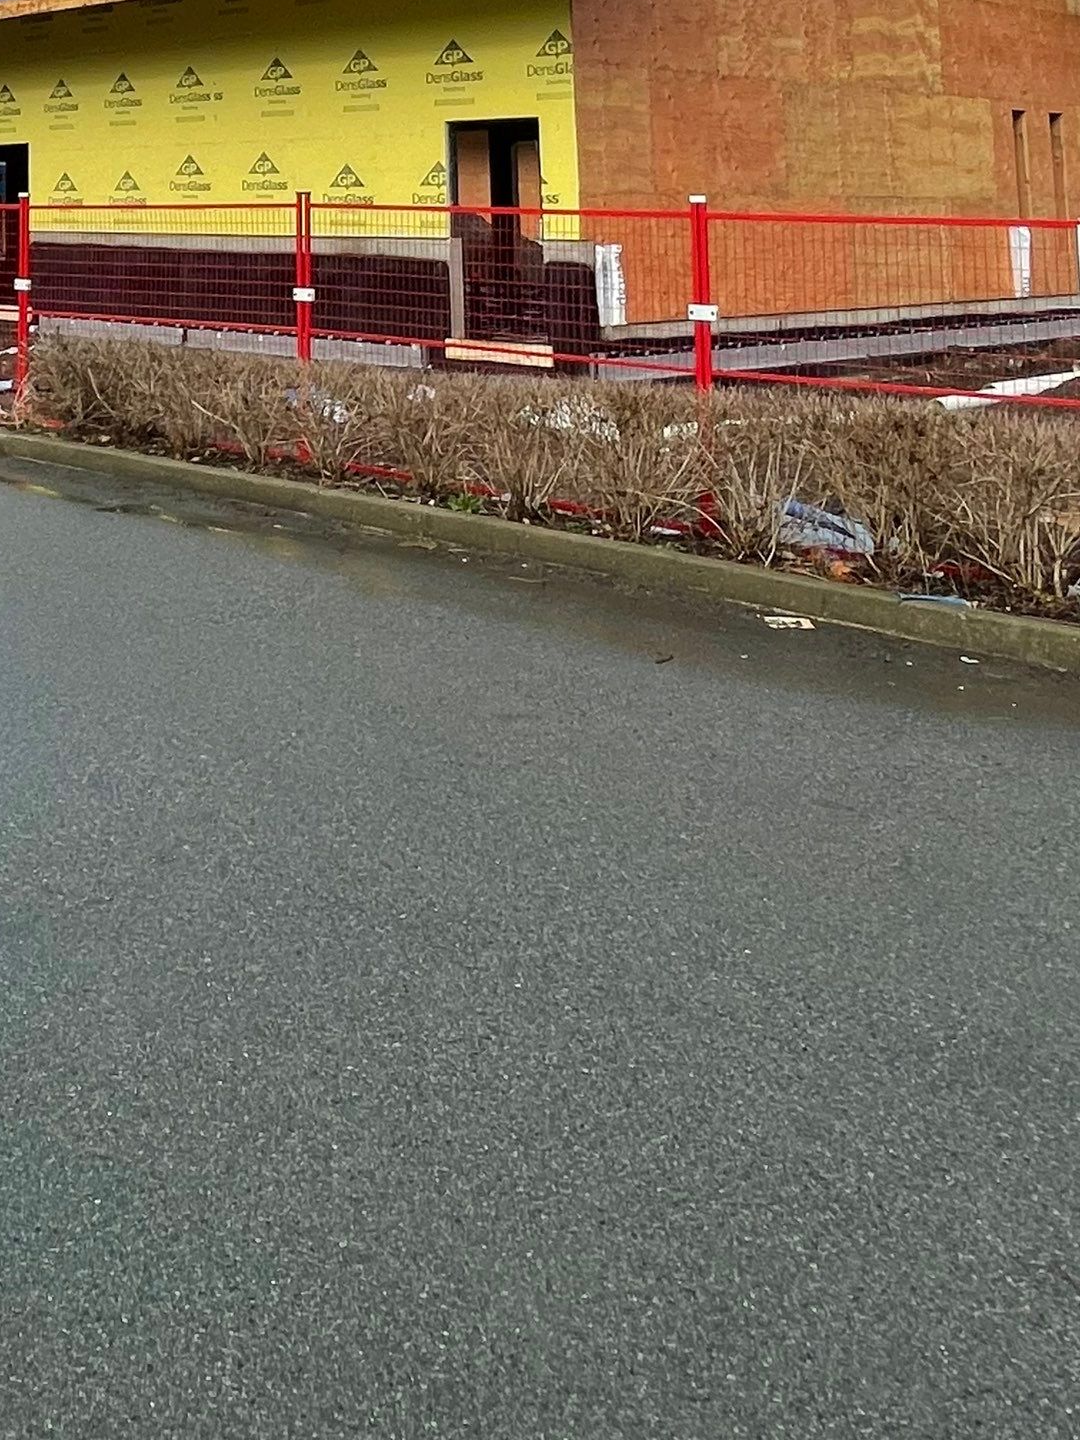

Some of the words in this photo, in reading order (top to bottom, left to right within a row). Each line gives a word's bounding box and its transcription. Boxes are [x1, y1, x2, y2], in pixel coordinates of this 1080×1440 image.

[545, 40, 568, 55] GP
[442, 50, 464, 63] GP
[268, 66, 285, 78] GP
[350, 59, 369, 72] GP
[425, 70, 484, 84] DensGlass
[254, 85, 301, 97] DensGlass
[335, 78, 387, 91] DensGlass
[255, 160, 272, 172] GP
[242, 179, 288, 191] DensGlass
[338, 173, 356, 186] GP
